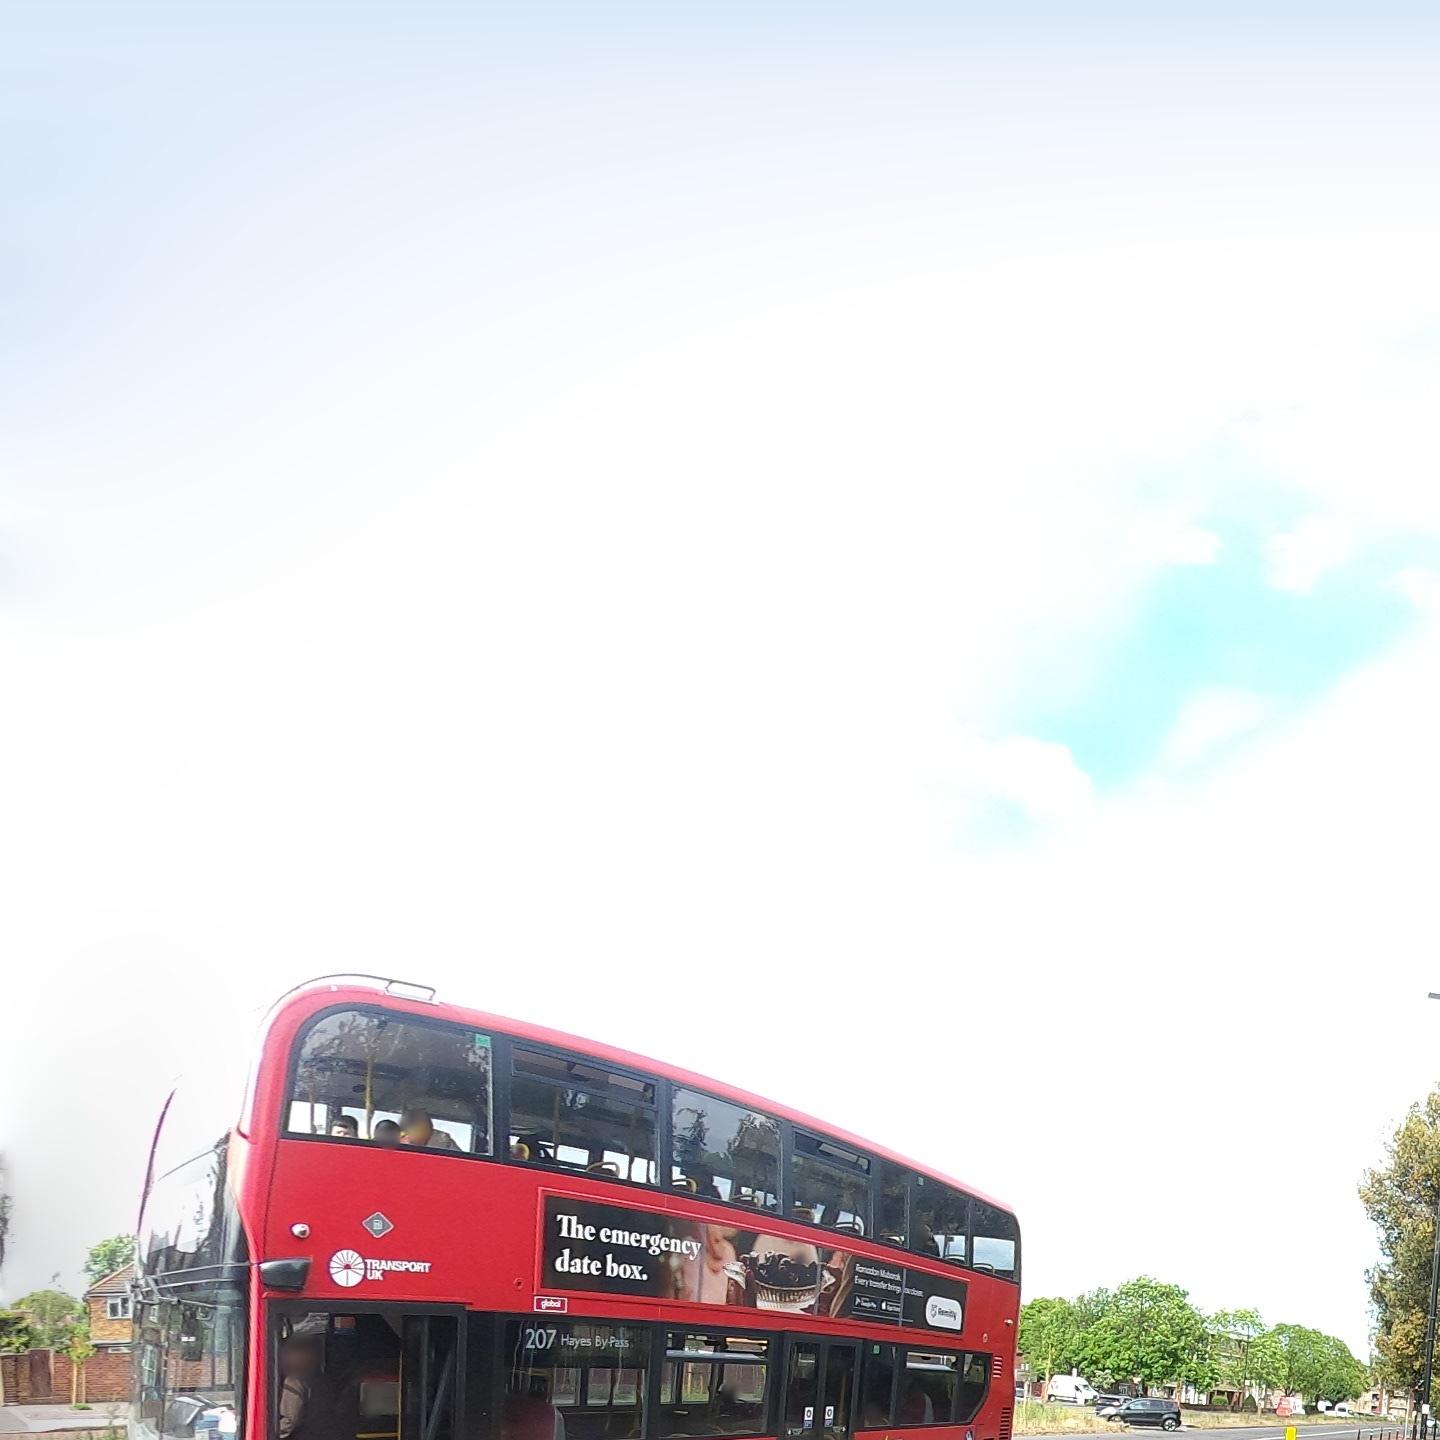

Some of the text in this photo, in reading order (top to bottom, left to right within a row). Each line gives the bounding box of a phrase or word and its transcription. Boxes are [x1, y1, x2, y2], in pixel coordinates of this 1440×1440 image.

[556, 1214, 702, 1261] The emergency
[364, 1258, 432, 1274] TRANSPORT
[554, 1248, 649, 1281] date box.
[365, 1269, 384, 1281] UK
[541, 1298, 561, 1310] global
[525, 1328, 557, 1350] 207
[560, 1333, 592, 1350] Hayes
